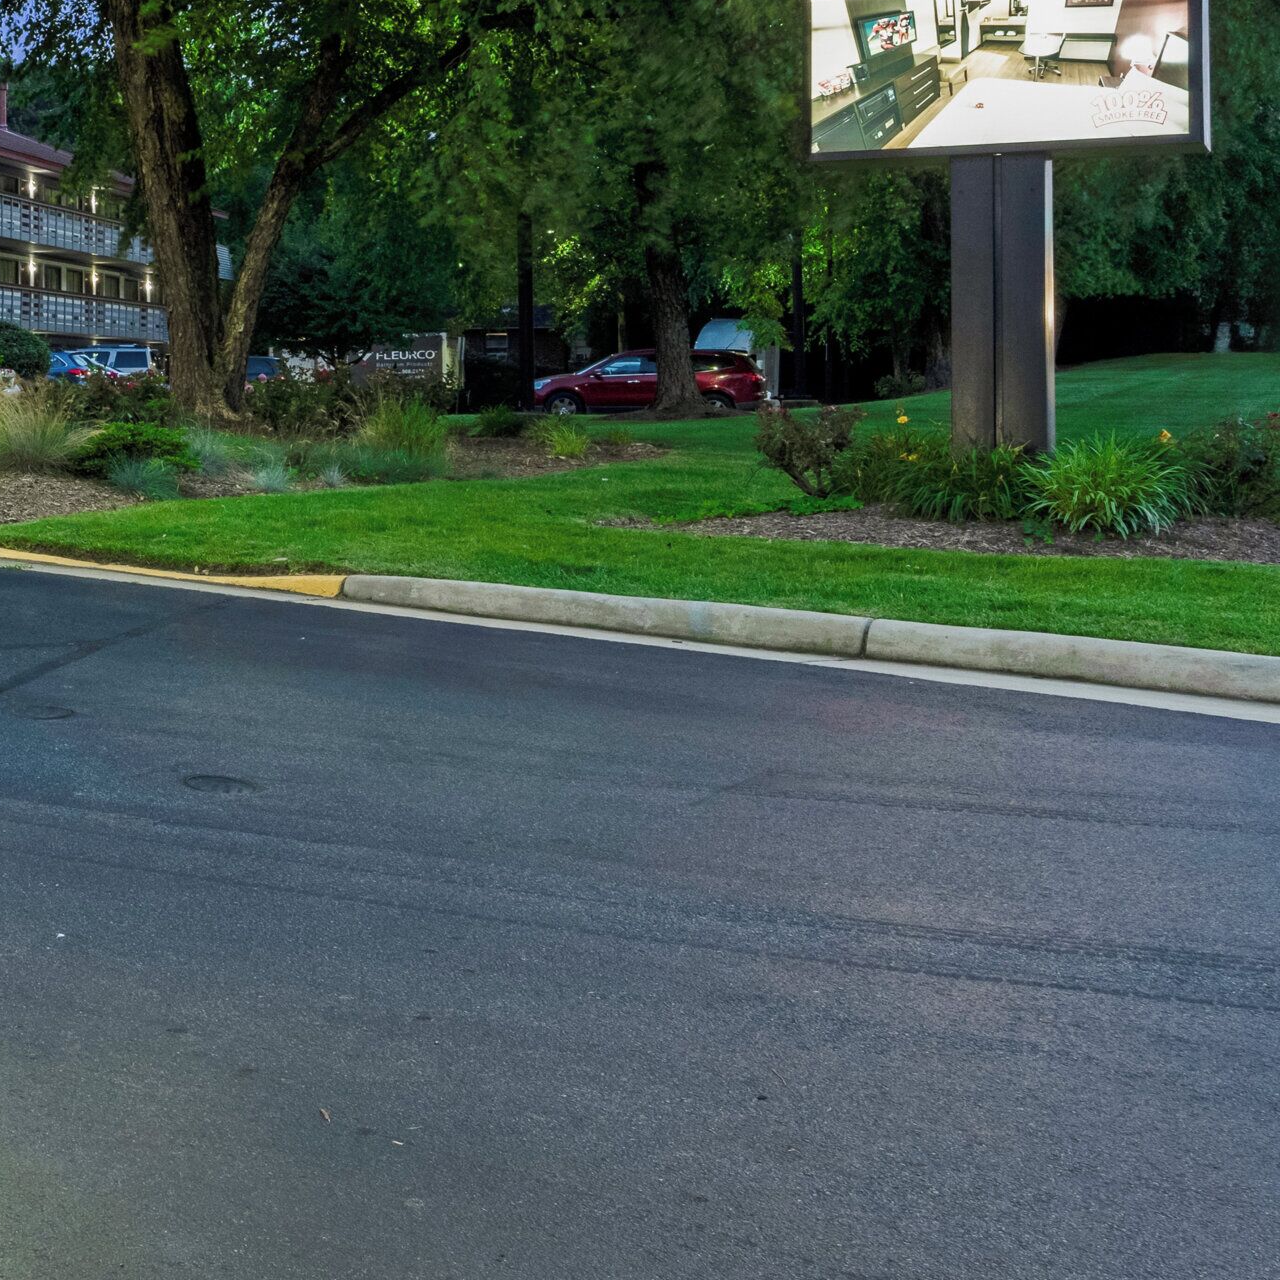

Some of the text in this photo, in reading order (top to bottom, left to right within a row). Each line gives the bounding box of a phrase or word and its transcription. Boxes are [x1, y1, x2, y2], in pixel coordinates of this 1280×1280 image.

[1091, 90, 1164, 112] 100%
[1097, 110, 1163, 122] SMOKE FREE
[375, 350, 436, 360] FLEURCO
